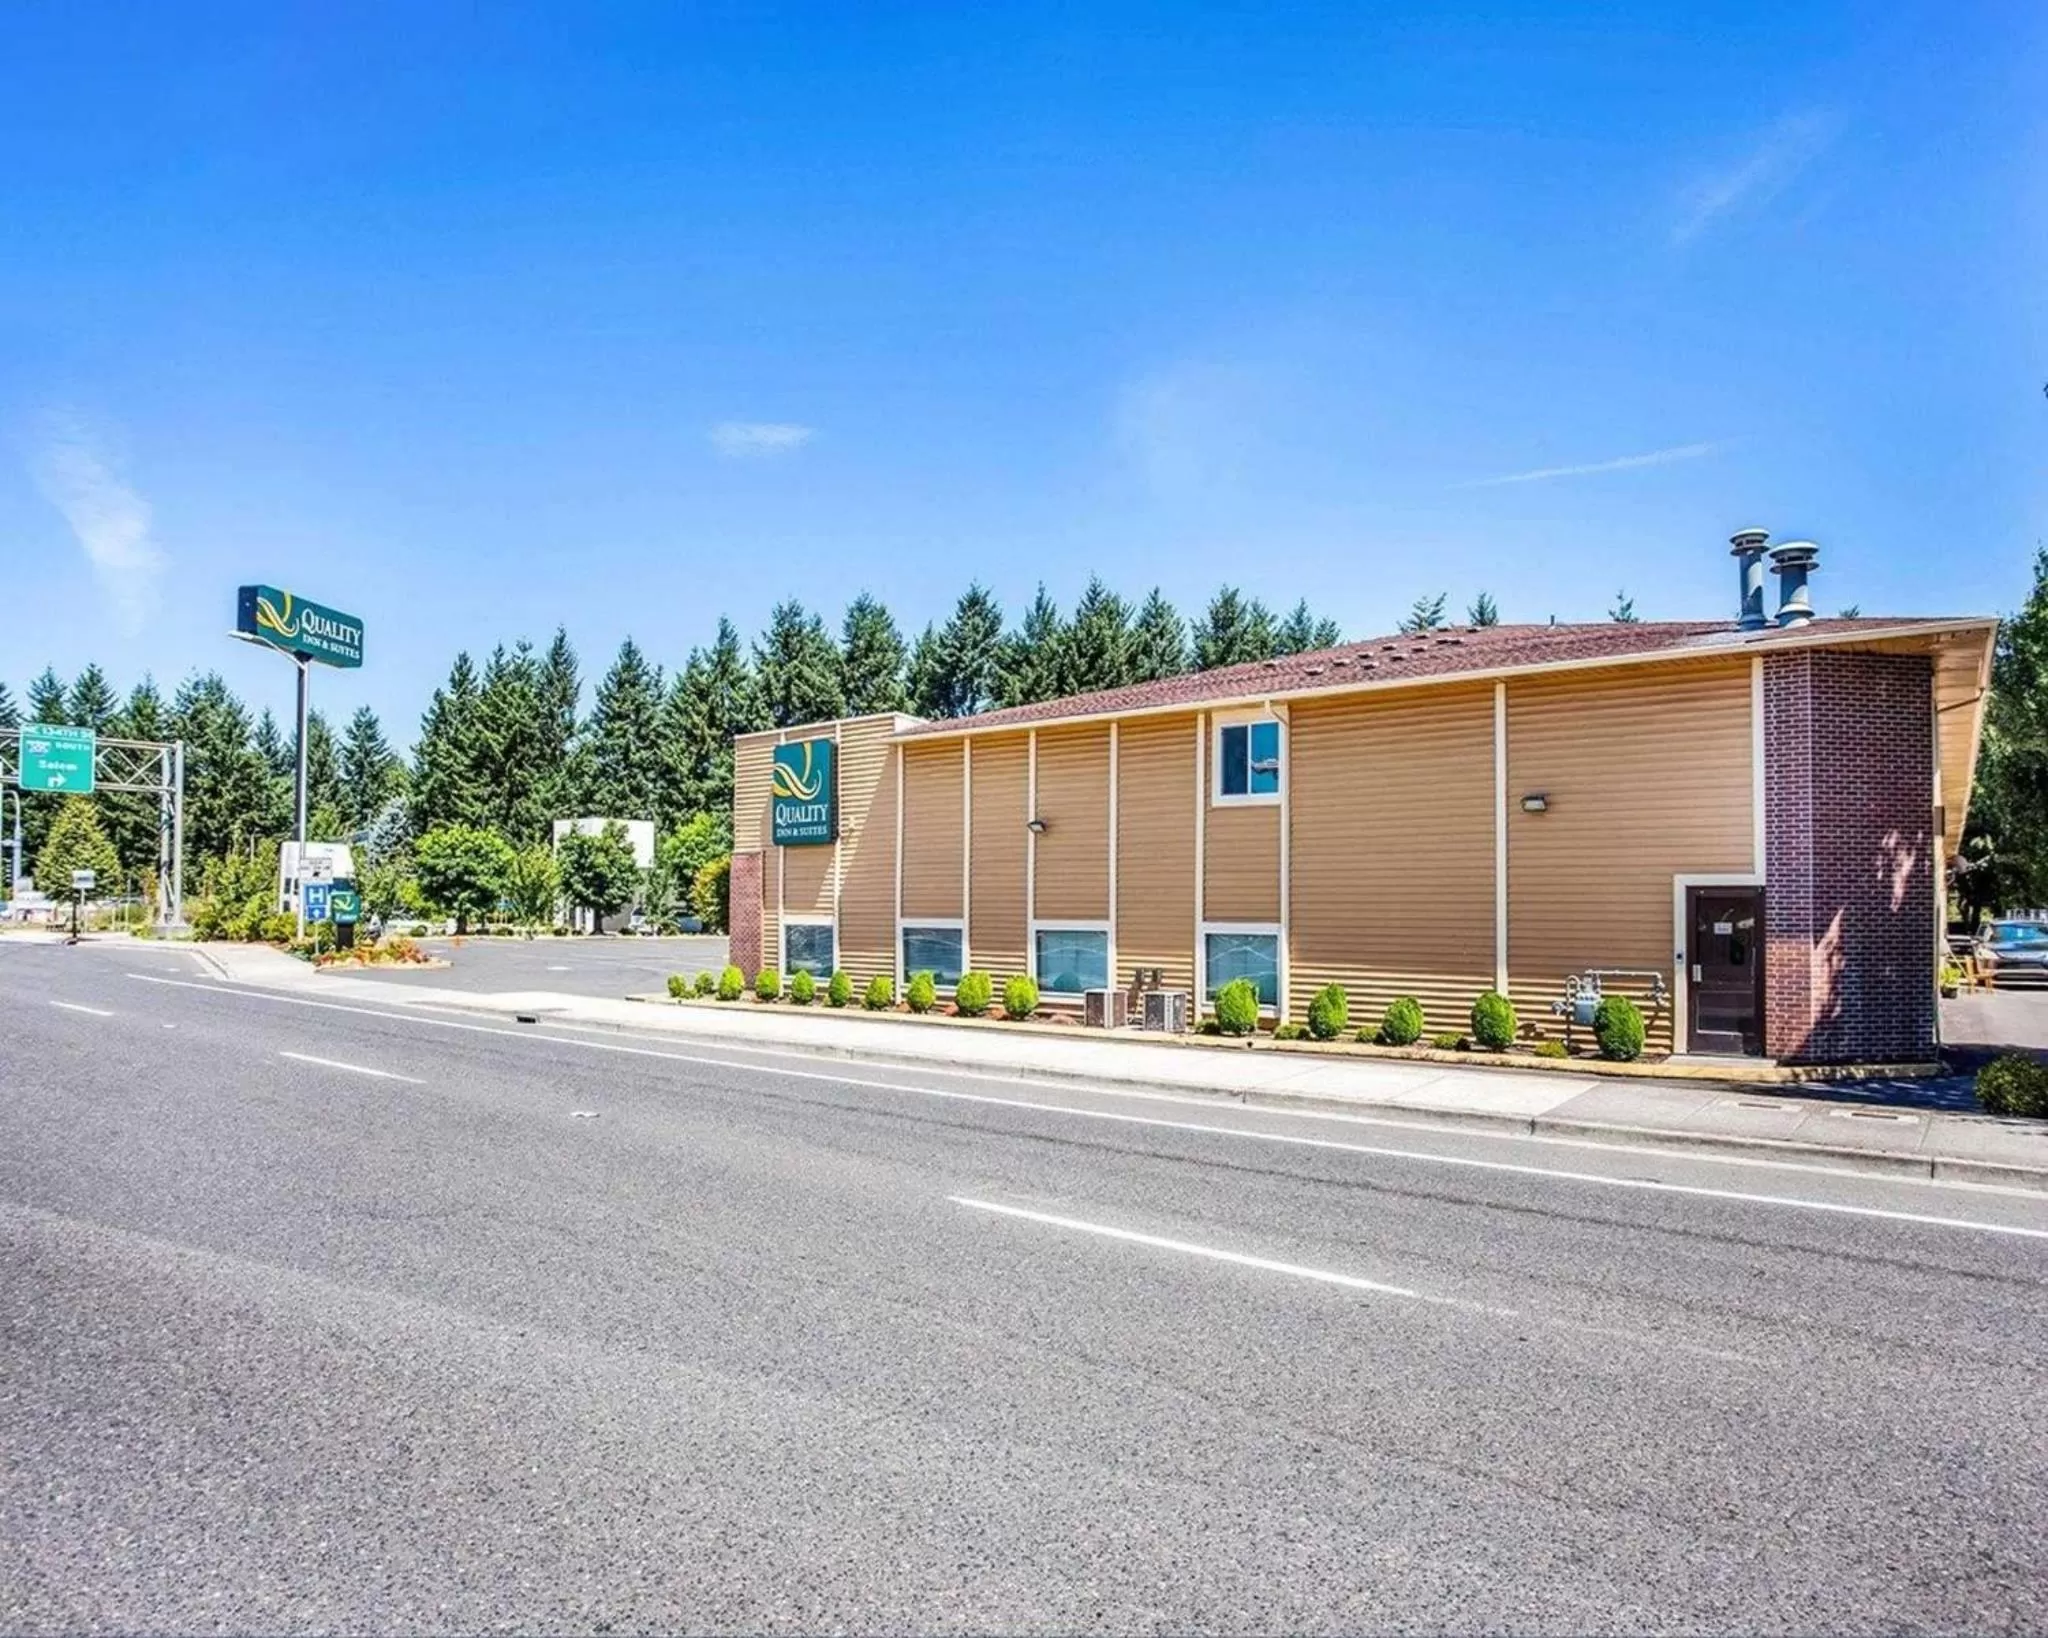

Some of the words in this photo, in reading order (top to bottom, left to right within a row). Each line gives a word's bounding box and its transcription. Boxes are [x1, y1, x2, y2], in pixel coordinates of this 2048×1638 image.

[301, 608, 361, 646] QUALITY
[303, 633, 321, 647] INN
[322, 640, 329, 649] &
[330, 642, 360, 659] SUITES
[38, 759, 78, 771] Salem
[776, 803, 828, 827] QUALITY
[776, 828, 791, 837] INN
[799, 825, 827, 837] SUITES
[308, 887, 324, 904] H
